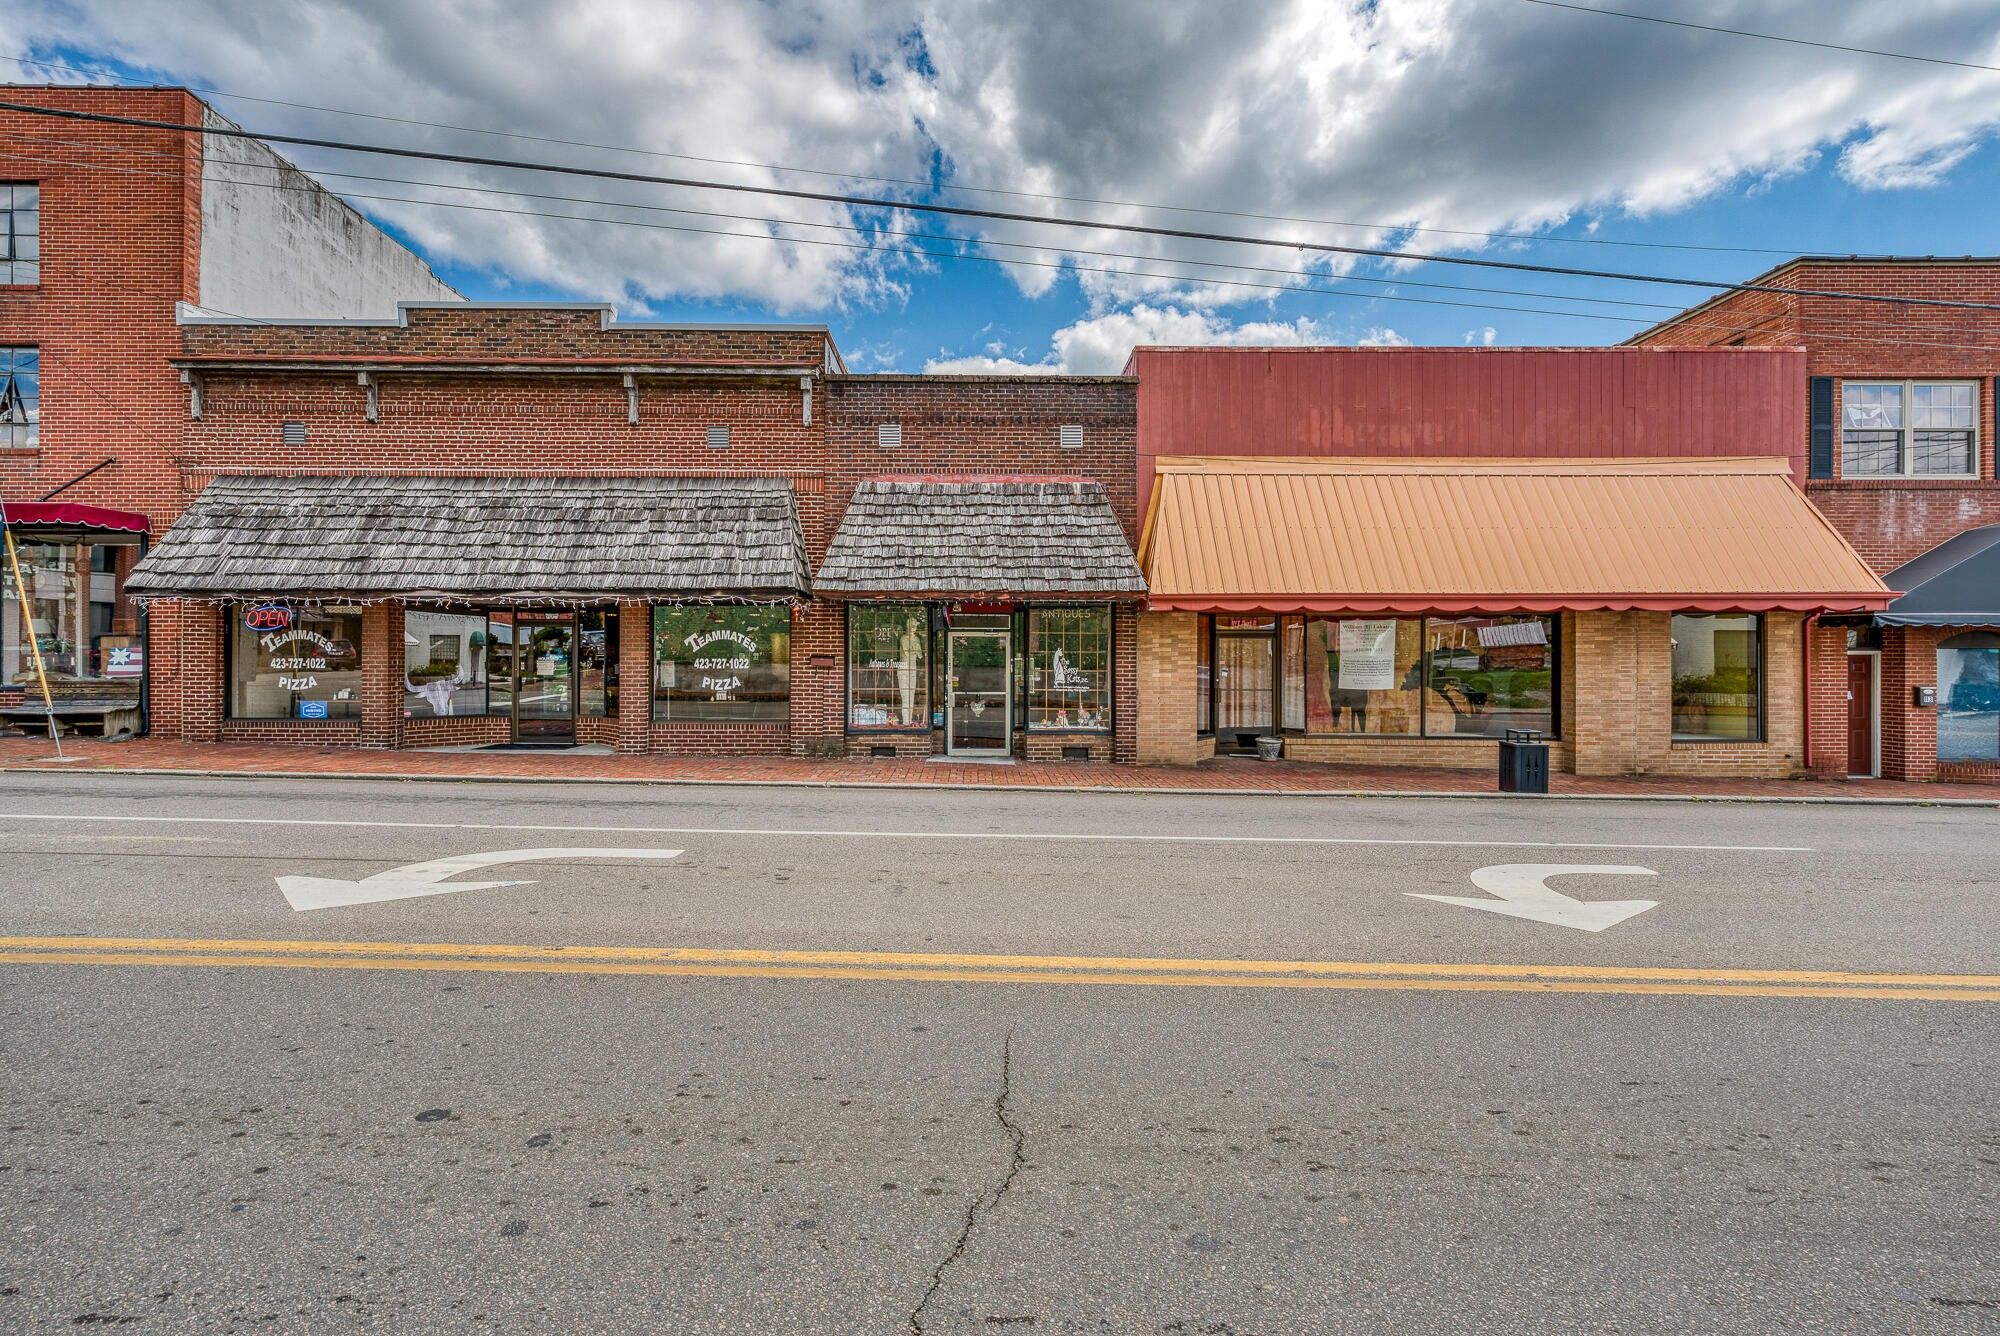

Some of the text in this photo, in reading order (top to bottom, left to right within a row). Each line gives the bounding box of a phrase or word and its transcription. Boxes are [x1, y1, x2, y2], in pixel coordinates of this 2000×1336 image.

[246, 609, 289, 627] OPEN
[1041, 608, 1091, 619] ANTIQUES
[270, 658, 326, 669] 423-727-1022
[694, 659, 750, 670] 423-727-1022
[278, 676, 318, 691] PIZZA
[702, 676, 742, 691] PIZZA
